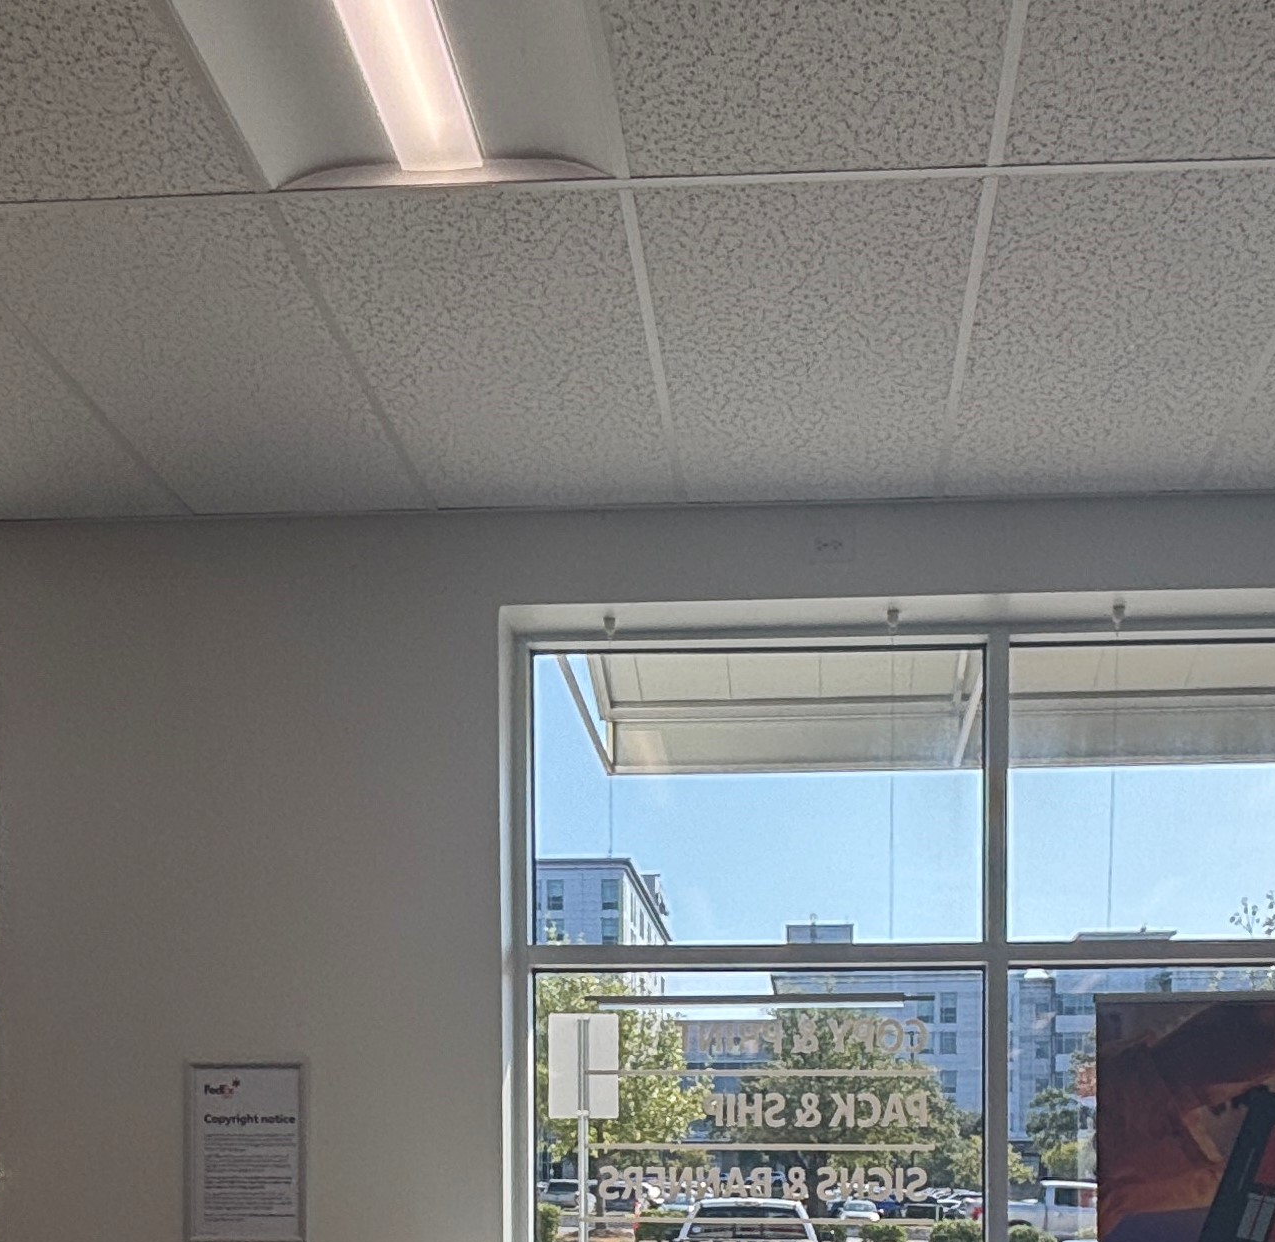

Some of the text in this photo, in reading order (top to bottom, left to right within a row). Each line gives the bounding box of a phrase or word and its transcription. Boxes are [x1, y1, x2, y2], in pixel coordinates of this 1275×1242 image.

[203, 1083, 234, 1096] FedEx
[203, 1113, 296, 1127] Copyright notice
